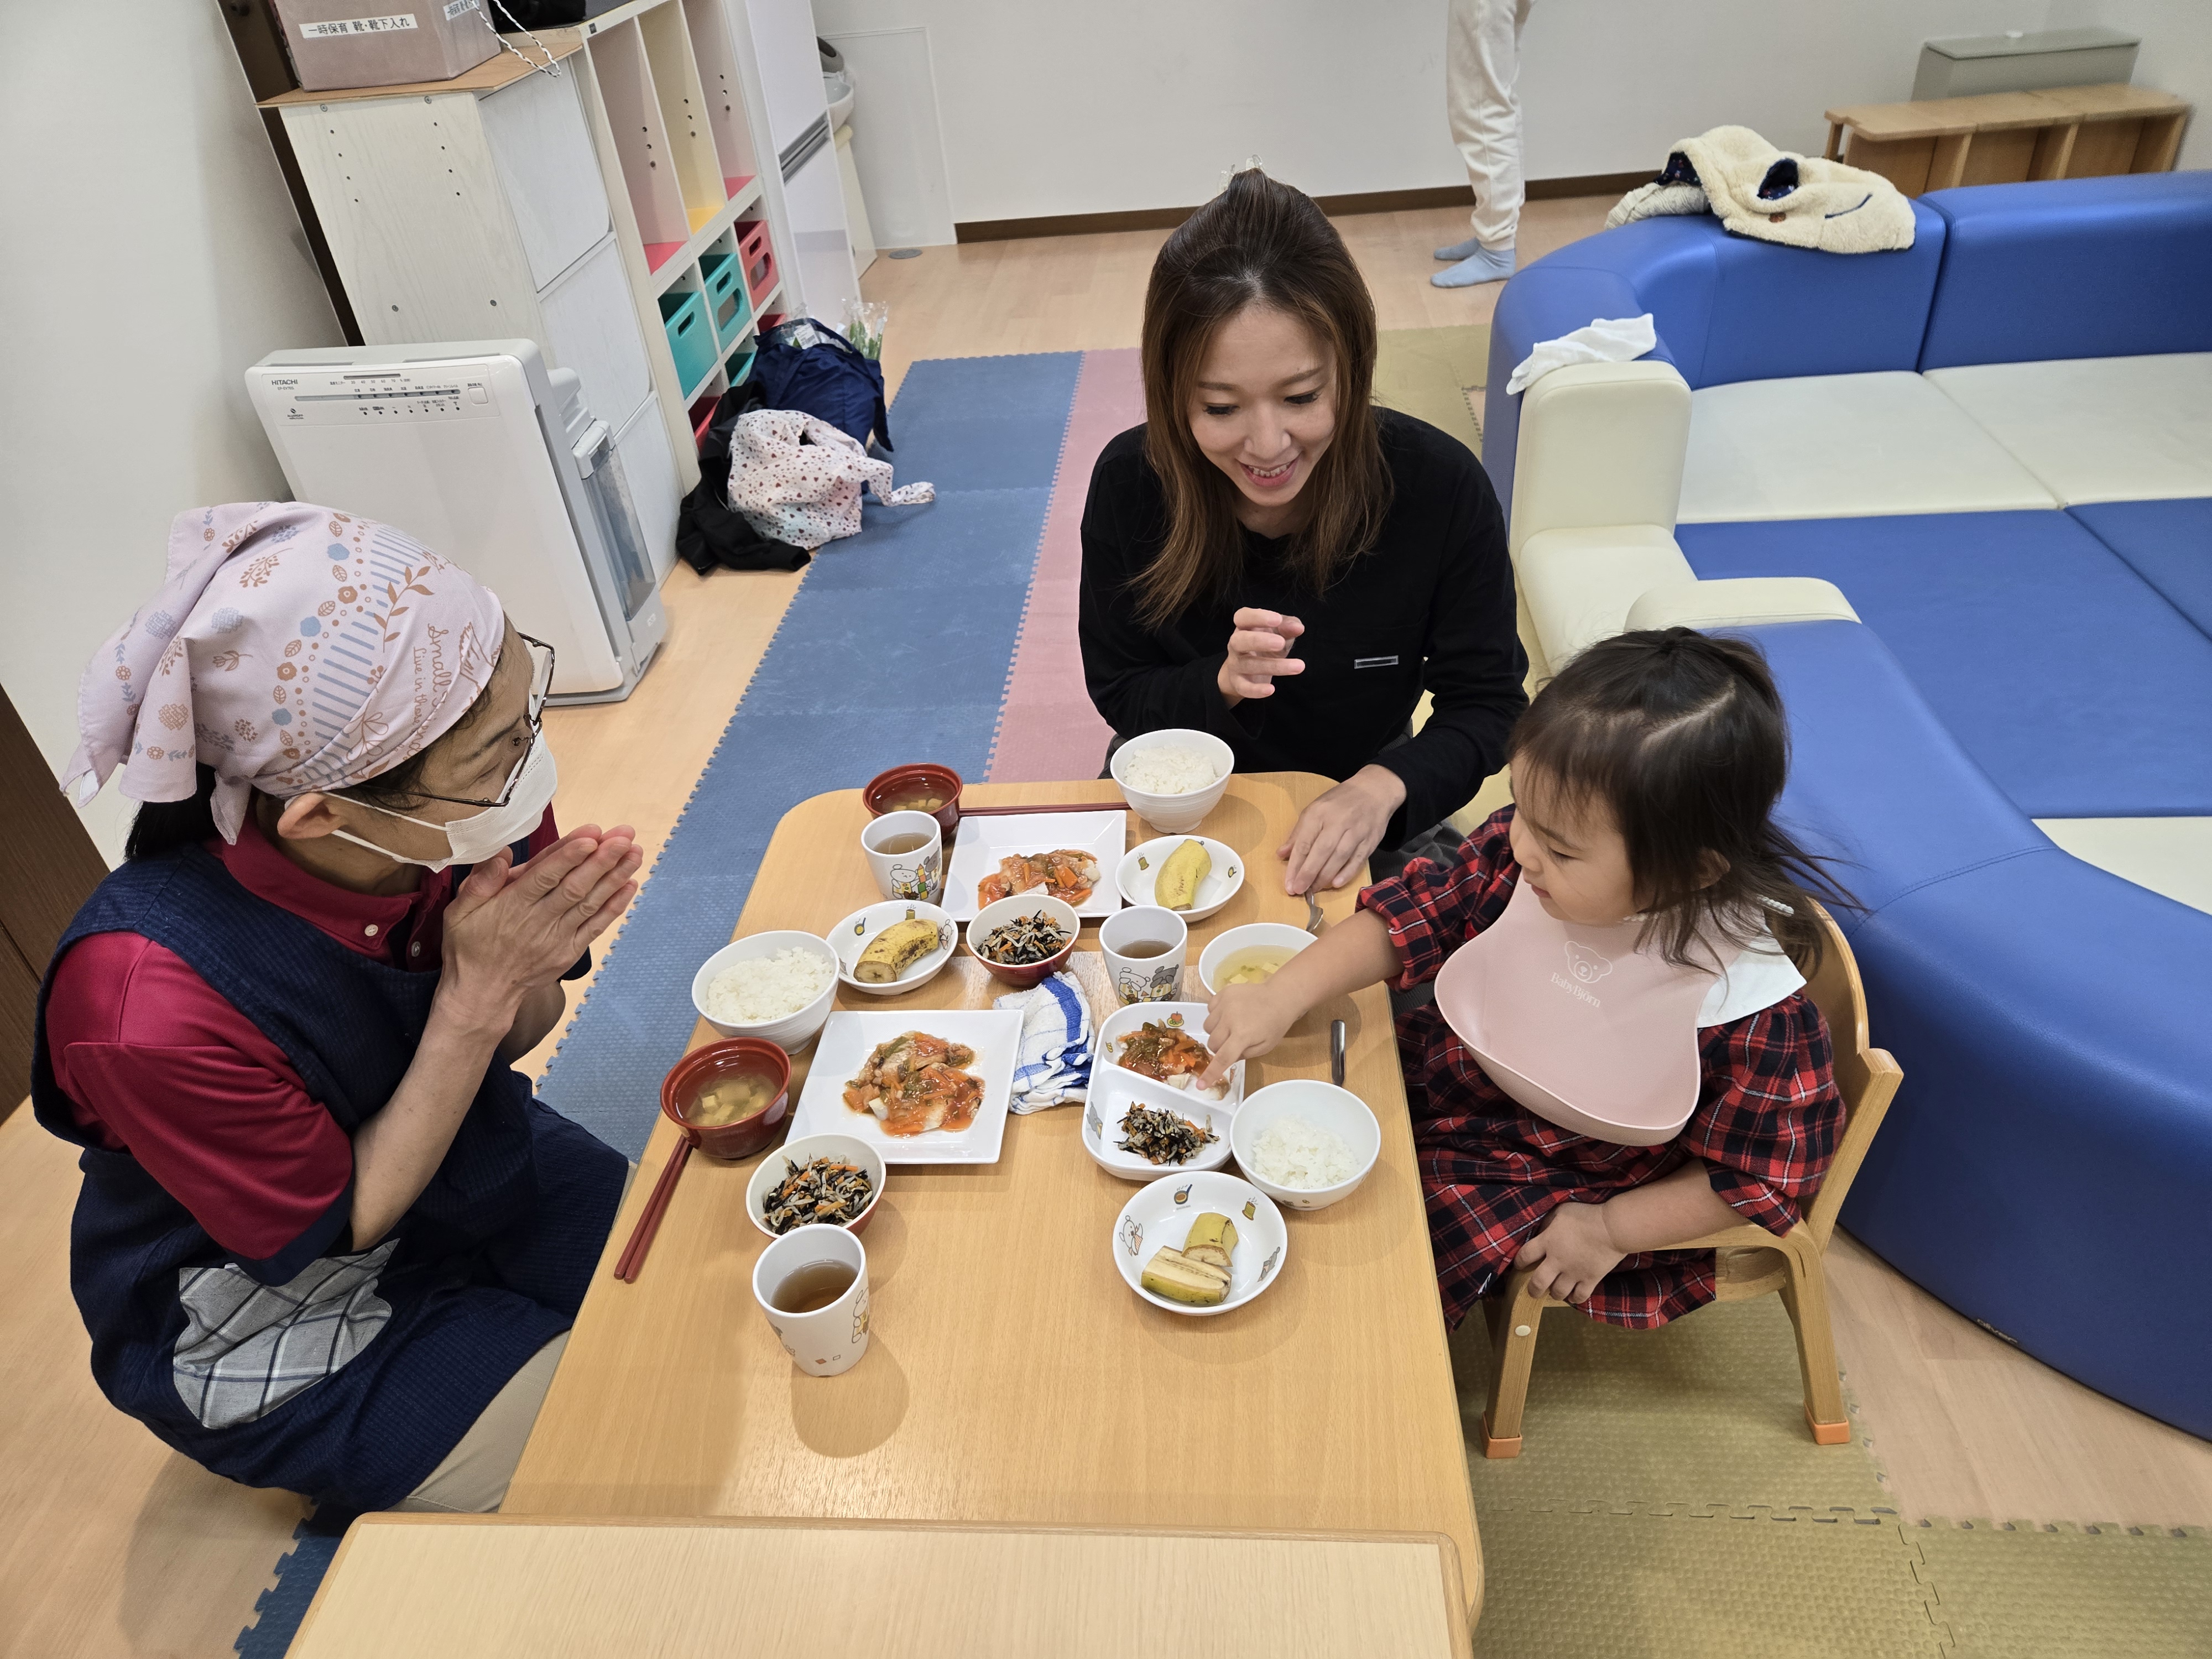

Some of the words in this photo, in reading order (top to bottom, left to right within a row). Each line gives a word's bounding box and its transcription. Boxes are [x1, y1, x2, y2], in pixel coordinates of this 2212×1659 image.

[309, 23, 348, 34] 一時保育
[414, 646, 427, 674] Live
[427, 623, 452, 692] Small
[415, 677, 426, 692] in
[1550, 972, 1601, 1008] BabyBjörn
